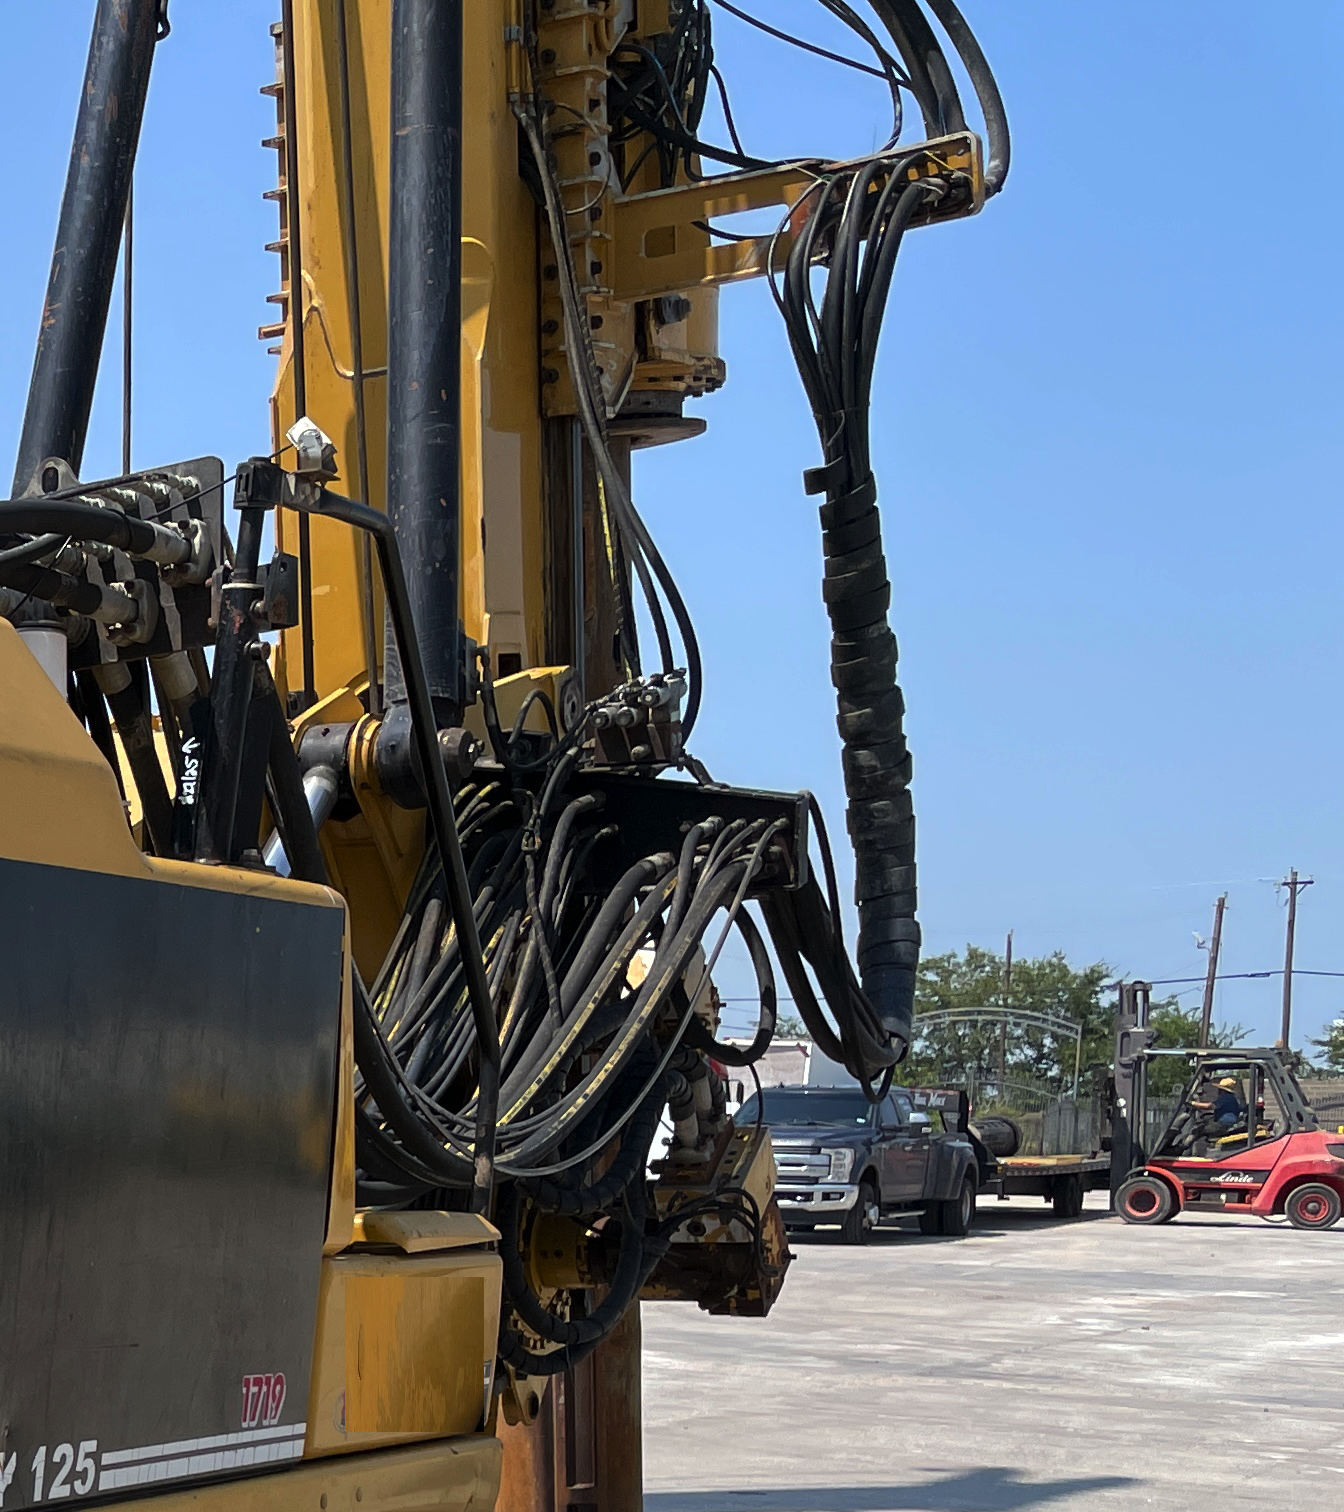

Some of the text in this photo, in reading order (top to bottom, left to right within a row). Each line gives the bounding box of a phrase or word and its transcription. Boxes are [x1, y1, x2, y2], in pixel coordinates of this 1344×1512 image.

[1210, 1171, 1254, 1183] Linde
[241, 1372, 287, 1429] 1719
[31, 1440, 98, 1502] 125
